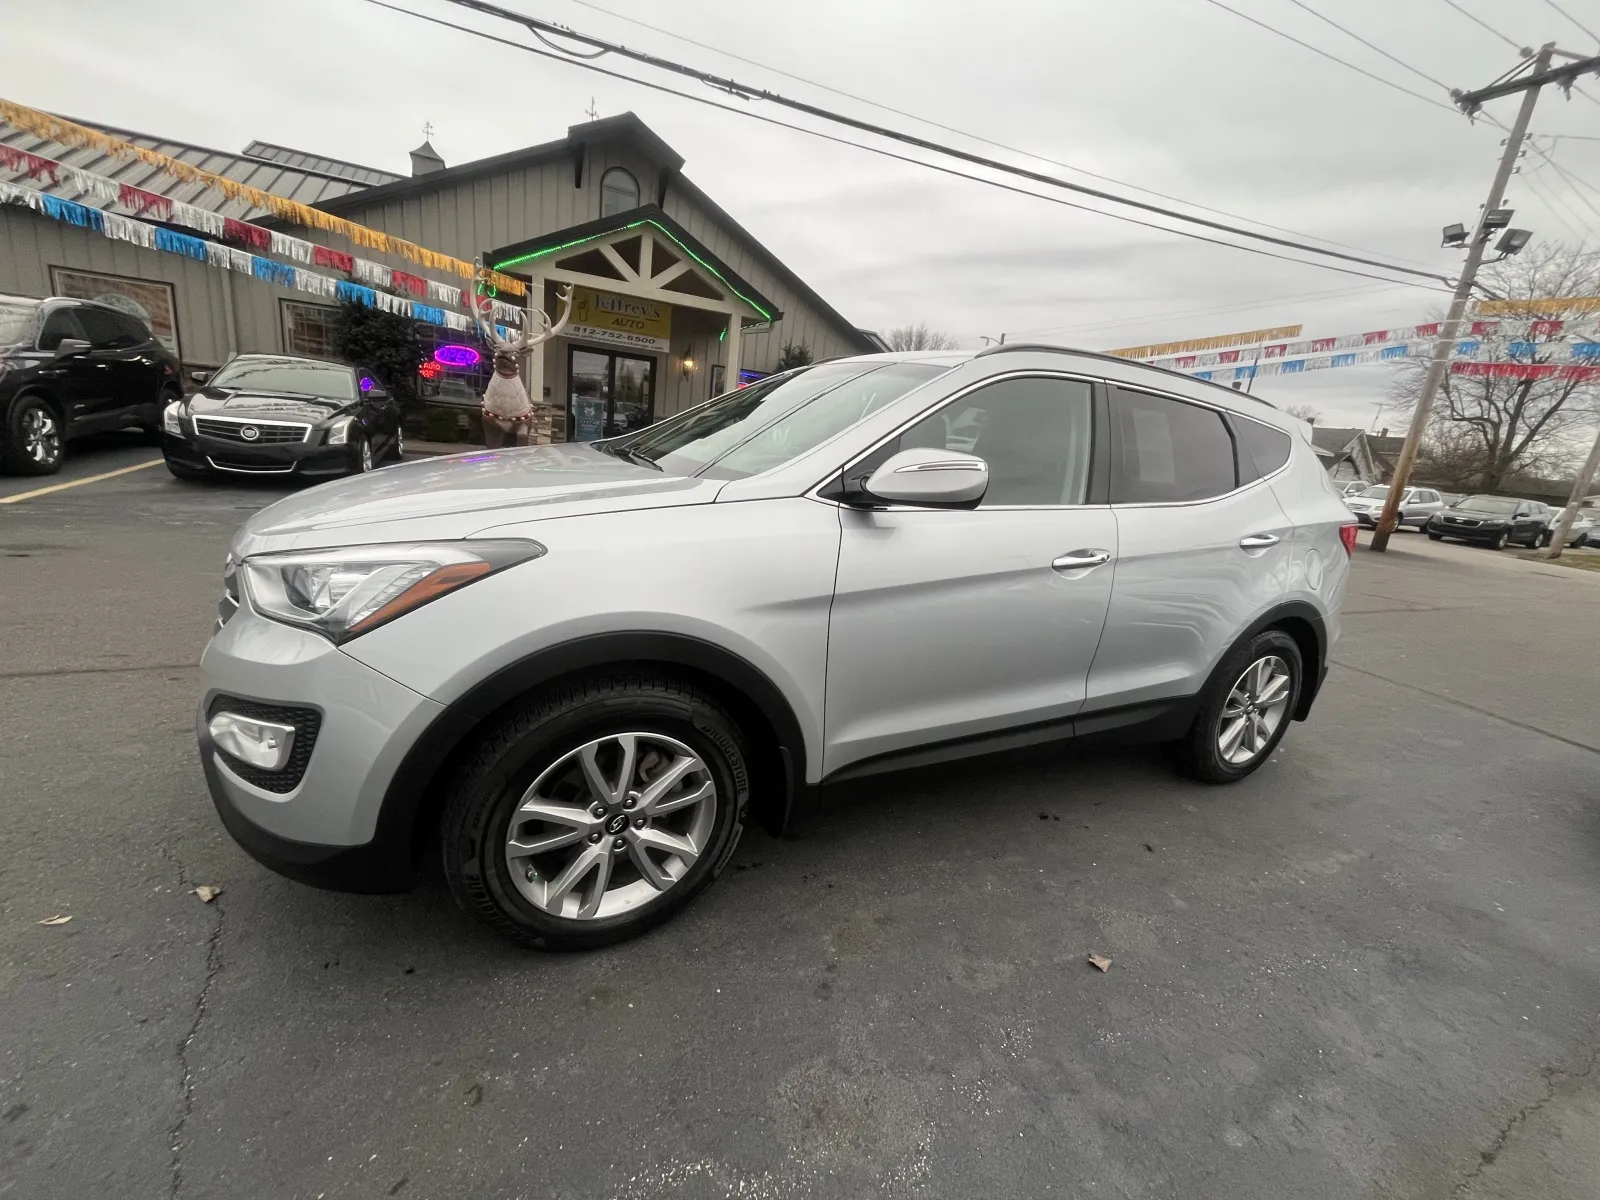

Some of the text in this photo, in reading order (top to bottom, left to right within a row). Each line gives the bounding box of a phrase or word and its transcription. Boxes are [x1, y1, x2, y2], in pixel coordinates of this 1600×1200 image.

[594, 292, 661, 318] Jeffrey's
[611, 317, 645, 330] AUTO
[573, 325, 656, 345] 812-752-6500
[439, 348, 475, 365] OPEN
[701, 723, 748, 795] BRIDGESTONE
